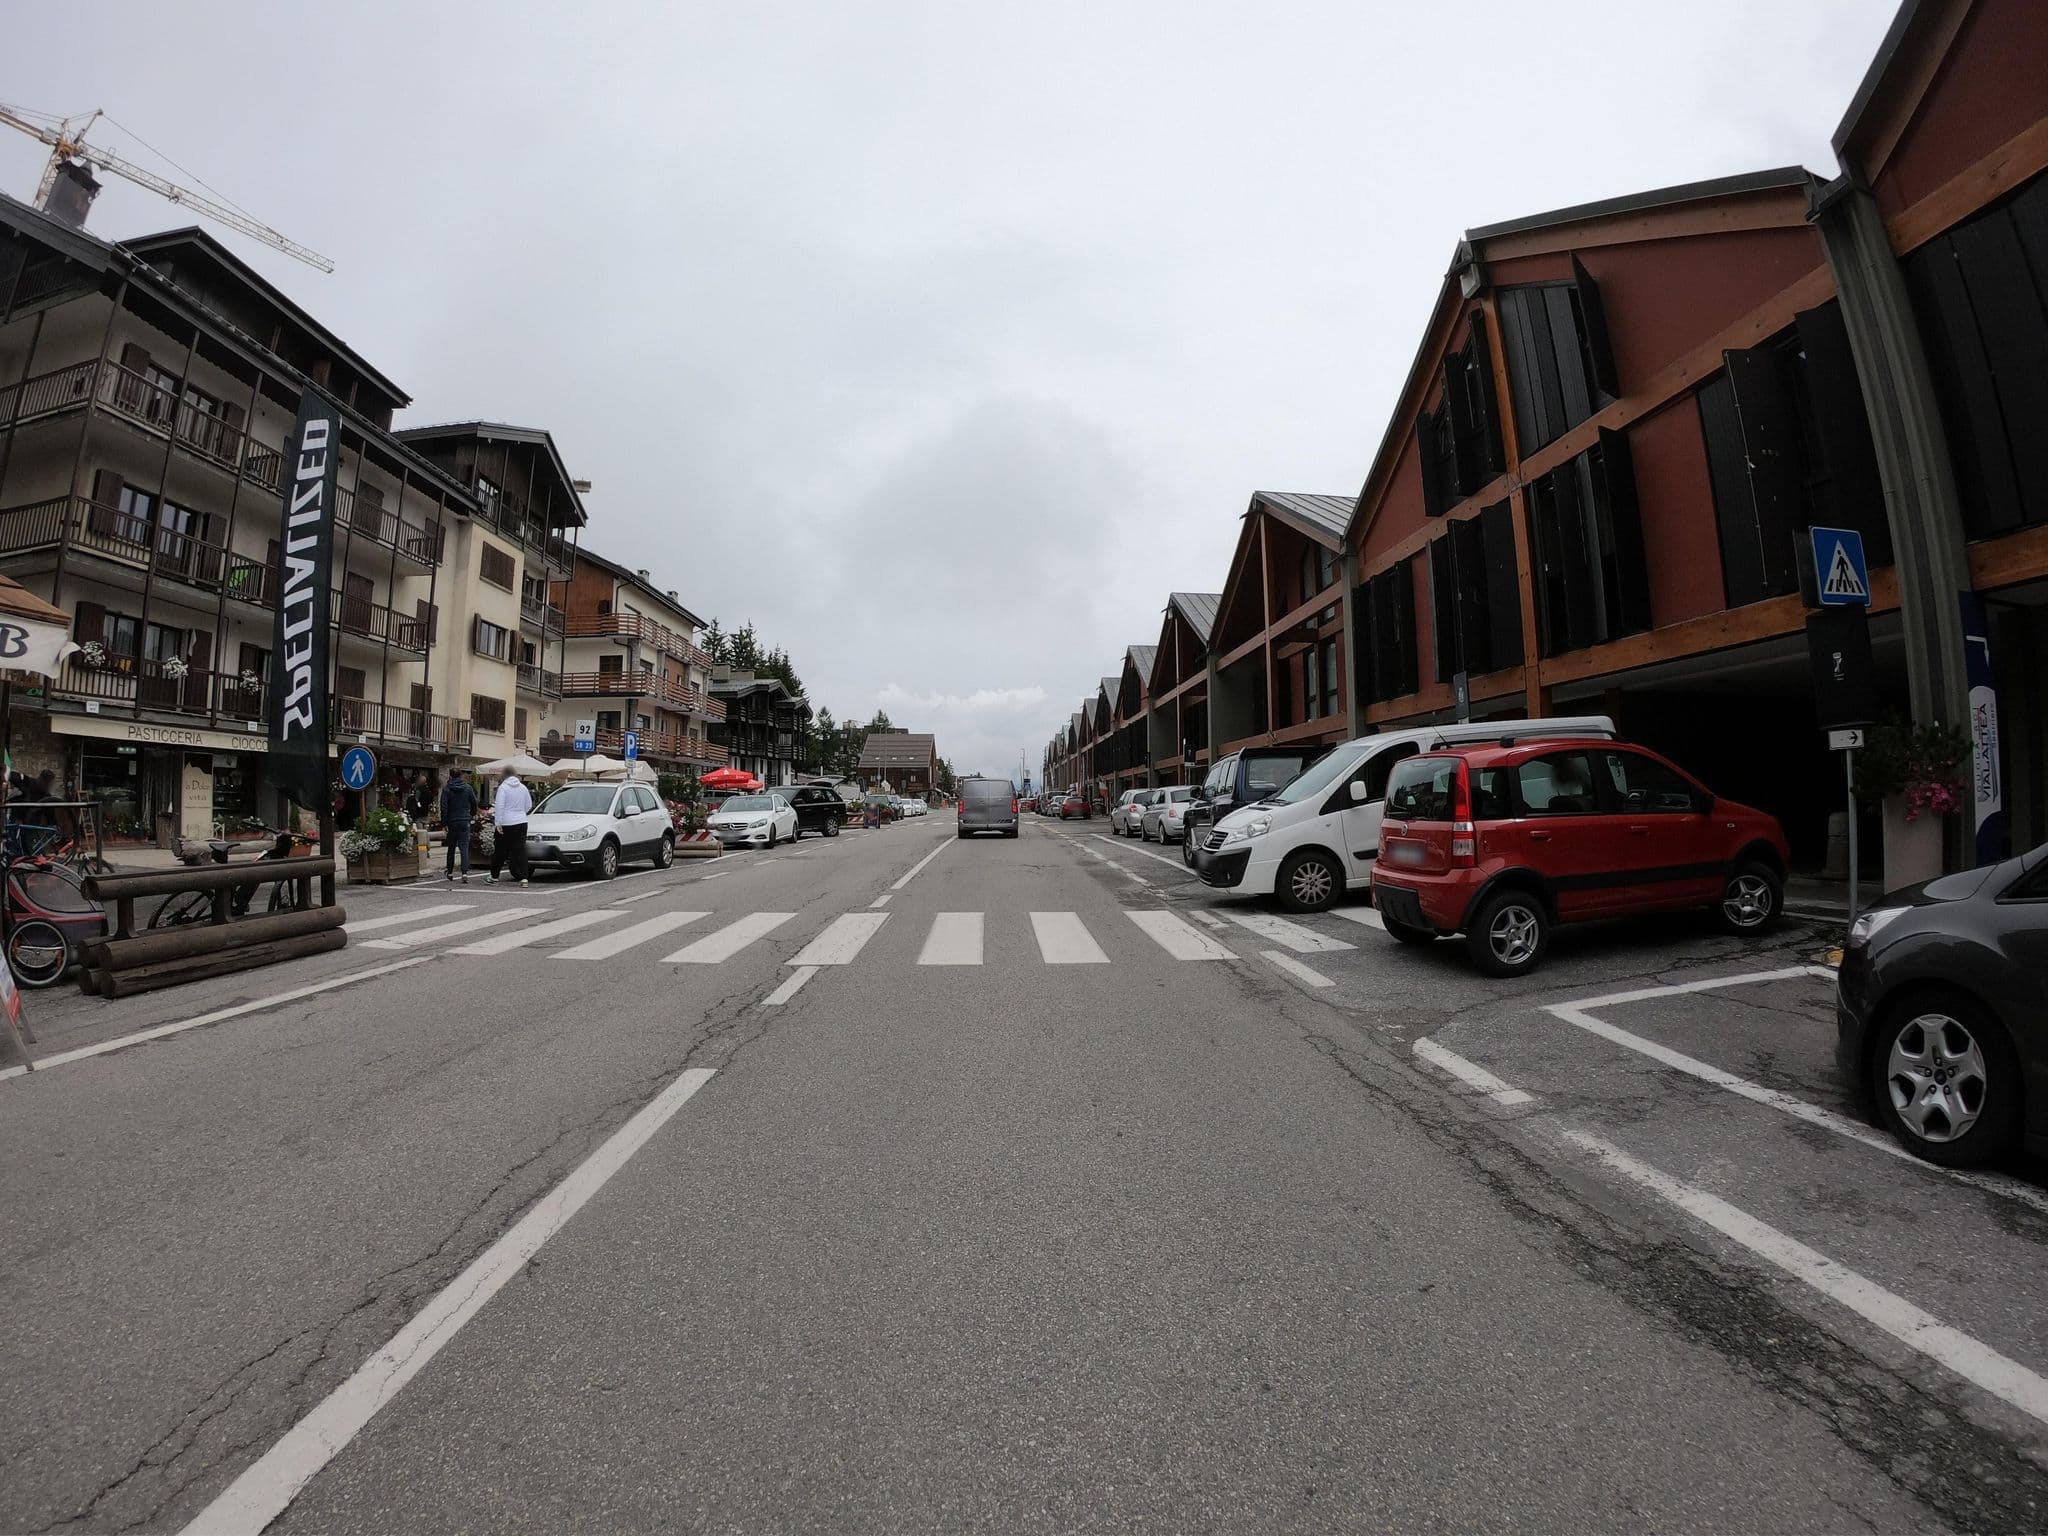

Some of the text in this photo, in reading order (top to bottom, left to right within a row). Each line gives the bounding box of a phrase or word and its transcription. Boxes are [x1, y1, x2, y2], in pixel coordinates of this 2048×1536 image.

[128, 726, 203, 745] PASTICCERIA
[579, 724, 591, 734] 92
[627, 734, 635, 756] P
